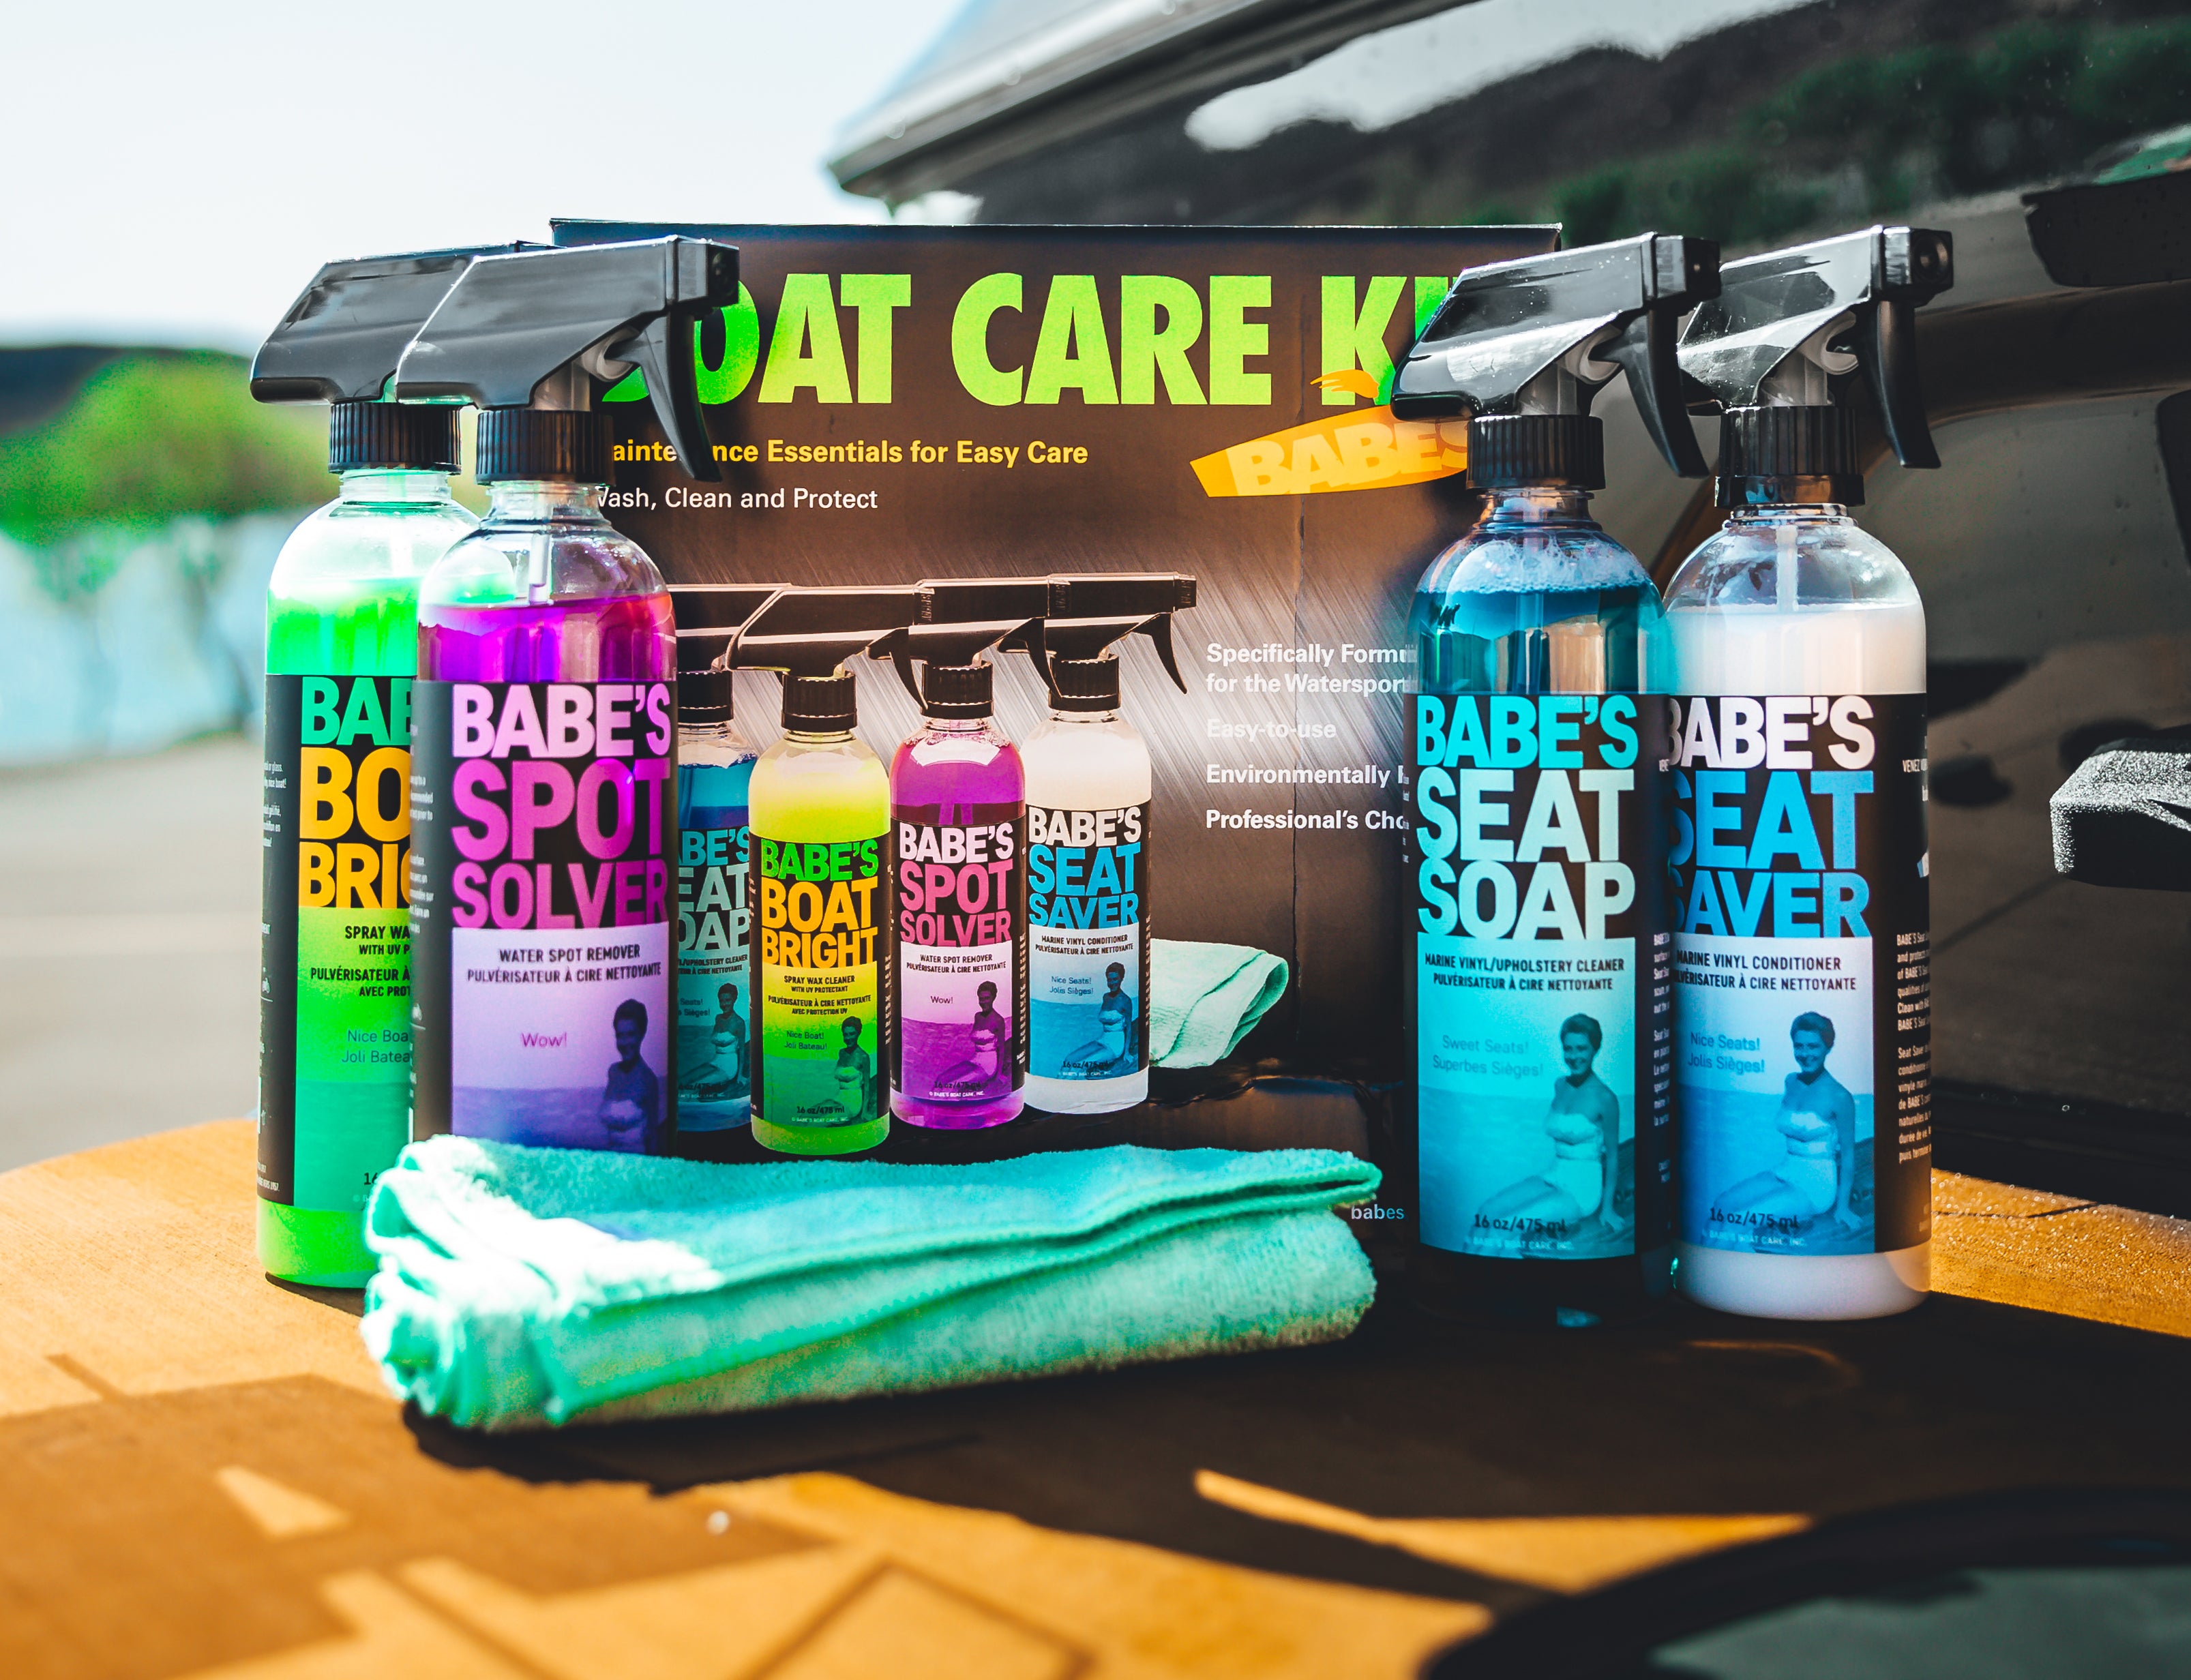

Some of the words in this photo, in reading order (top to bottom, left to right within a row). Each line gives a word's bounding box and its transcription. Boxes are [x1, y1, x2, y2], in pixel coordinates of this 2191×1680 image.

[602, 273, 911, 405] OAT
[951, 273, 1272, 406] CARE
[612, 439, 758, 462] aintence
[768, 439, 903, 463] Essentials
[910, 439, 949, 462] for
[957, 441, 1019, 468] Easy
[1027, 442, 1088, 464] Care
[665, 487, 732, 508] Clean
[741, 487, 786, 509] and
[793, 487, 878, 509] Protect
[1206, 643, 1335, 667] Specifically
[1206, 673, 1238, 693] for
[1244, 674, 1281, 693] the
[453, 682, 672, 758] BABE'S
[1206, 718, 1337, 742] Easy-to-use
[1417, 695, 1639, 768] BABE'S
[1206, 764, 1391, 788] Environmentally
[300, 747, 411, 842] BO
[451, 758, 671, 861] SPOT
[1206, 809, 1359, 830] Professional's
[1416, 766, 1635, 862] SEAT
[1669, 770, 1874, 870] SEAT
[1029, 806, 1142, 847] BABE'S
[679, 826, 749, 867] BE'S
[899, 822, 1014, 864] BABE'S
[761, 839, 879, 882] BABE'S
[1028, 842, 1141, 896] SEAT
[298, 842, 411, 909] BRI
[899, 859, 1013, 914] SPOT
[451, 859, 669, 929] SOLVER
[679, 862, 749, 912] EAT
[761, 875, 878, 933] BOAT
[1418, 857, 1636, 940] SOAP
[1028, 892, 1139, 929] SAVER
[345, 925, 386, 939] SPRAY
[390, 925, 410, 939] WA
[679, 908, 749, 950] OAP
[899, 910, 1011, 947] SOLVER
[1042, 935, 1064, 944] MARINE
[1066, 935, 1086, 945] VINYL
[1087, 934, 1128, 945] CONDITIONER
[359, 944, 385, 955] WITH
[387, 944, 401, 955] UV
[499, 948, 543, 963] WATER
[549, 948, 583, 962] SPOT
[587, 944, 640, 960] REMOVER
[761, 927, 878, 968] BRIGHT
[962, 954, 992, 962] REMOVER
[1101, 943, 1133, 954] NETTOYANTE
[973, 961, 1006, 972] NETTOYANTE
[1425, 953, 1456, 968] MARINE
[1459, 957, 1572, 972] VINYL/UPHOLSTERY
[1577, 958, 1624, 972] CLEANER
[1677, 950, 1710, 966] MARINE
[1714, 953, 1748, 968] VINYL
[1753, 956, 1841, 970] CONDITIONER
[311, 965, 399, 980] PULVÉRISATEUR
[467, 967, 561, 983] PULVÉRISATEUR
[565, 966, 572, 982] À
[576, 968, 602, 982] CIRE
[606, 962, 661, 980] NETTOYANTE
[784, 976, 805, 984] SPRAY
[807, 976, 823, 985] WAX
[825, 975, 855, 984] CLEANER
[1433, 972, 1506, 989] PULVÉRISATEUR
[1508, 975, 1515, 989] À
[1519, 979, 1543, 990] CIRE
[1547, 978, 1613, 991] NETTOYANTE
[1739, 972, 1746, 989] À
[1750, 976, 1776, 990] CIRE
[1781, 978, 1856, 991] NETTOYANTE
[359, 986, 384, 996] AVEC
[820, 998, 835, 1006] CIRE
[837, 995, 871, 1006] NETTOYANTE
[930, 995, 953, 1004] Wow!
[347, 1030, 377, 1042] Nice
[383, 1030, 408, 1042] Boa
[521, 1032, 567, 1047] Wow!
[1442, 1035, 1479, 1051] Sweet
[1485, 1038, 1529, 1054] Seats!
[1690, 1032, 1714, 1047] Nice
[1718, 1035, 1760, 1051] Seats!
[342, 1050, 366, 1063] Joli
[371, 1050, 410, 1063] Batea
[1433, 1055, 1487, 1074] Superbes
[1491, 1059, 1543, 1079] Sièges!
[1688, 1053, 1712, 1068] Jolis
[1716, 1057, 1765, 1075] Sièges!
[1475, 1214, 1490, 1228] 16
[1493, 1216, 1542, 1232] oz/475
[1710, 1207, 1724, 1222] 16
[1727, 1210, 1775, 1227] oz/475
